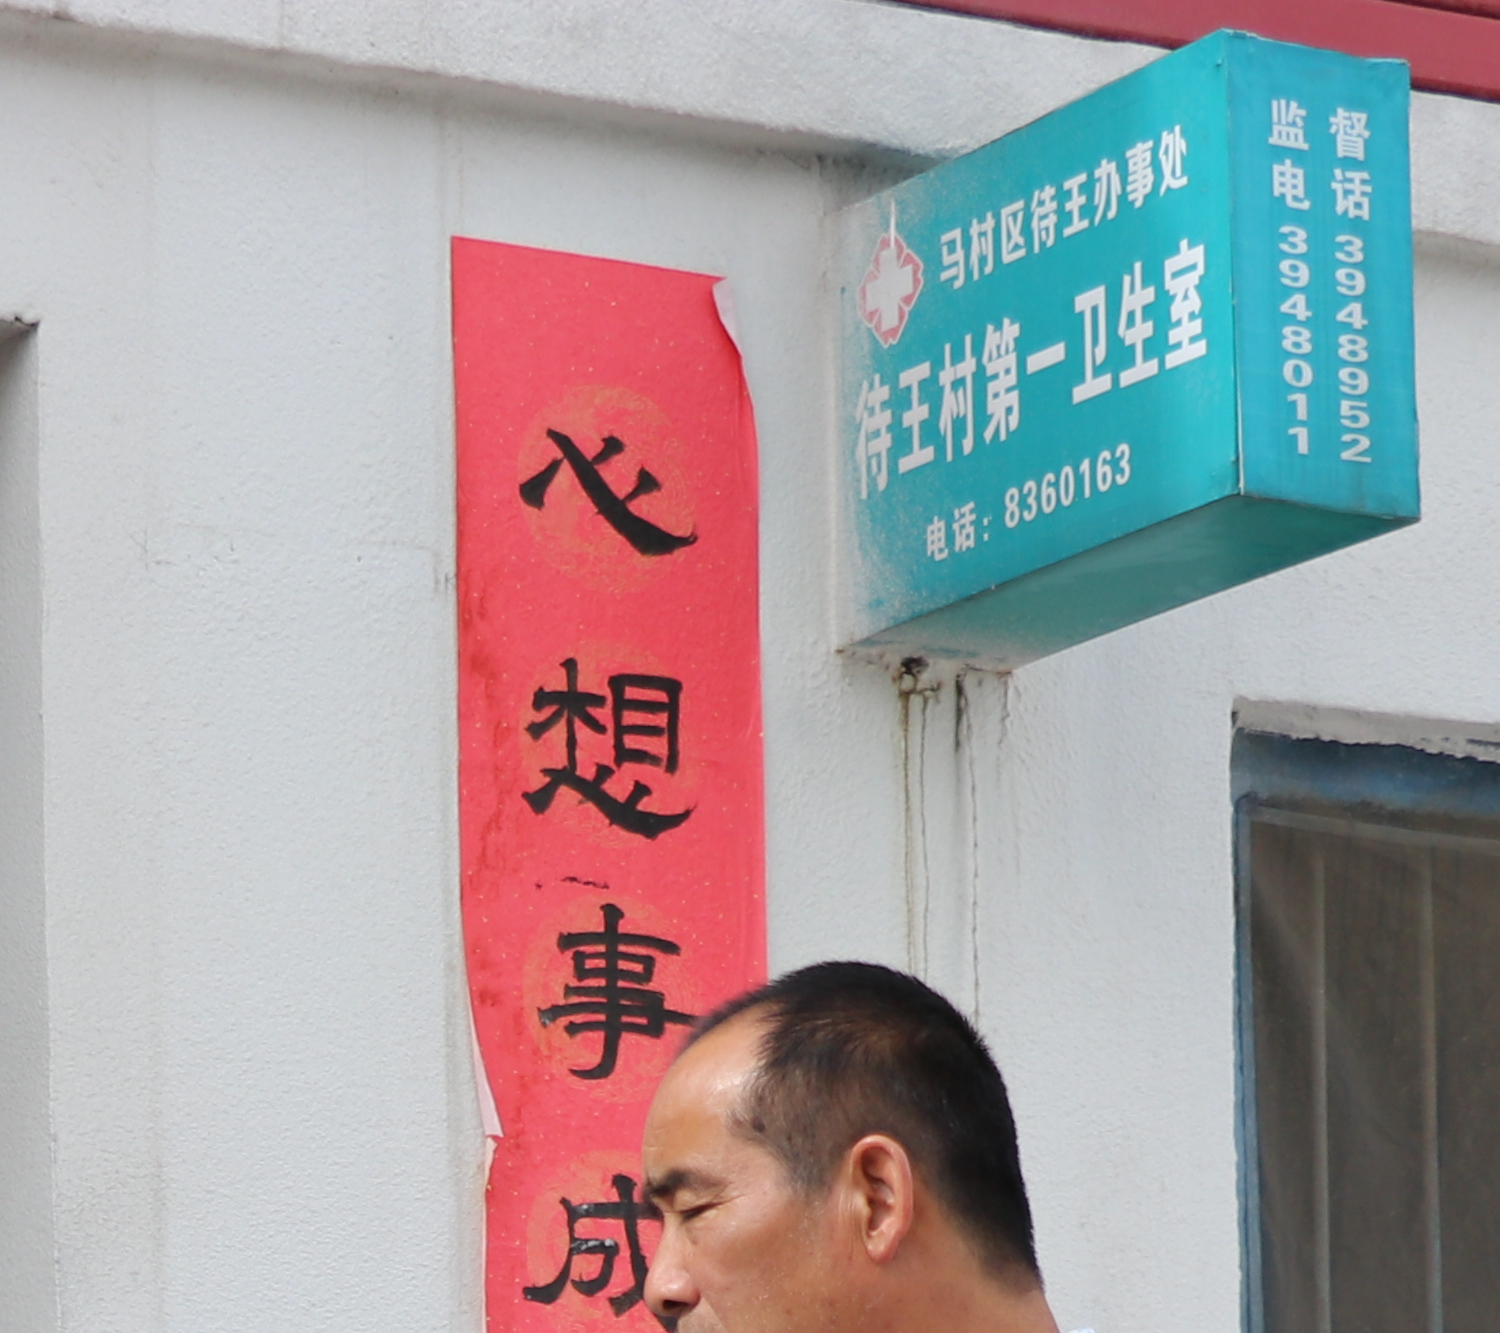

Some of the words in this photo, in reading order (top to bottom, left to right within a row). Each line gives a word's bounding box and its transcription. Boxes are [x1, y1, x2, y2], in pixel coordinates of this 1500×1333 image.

[938, 125, 1189, 291] 马村区待王办事处
[854, 238, 1208, 500] 待王村第一卫生室
